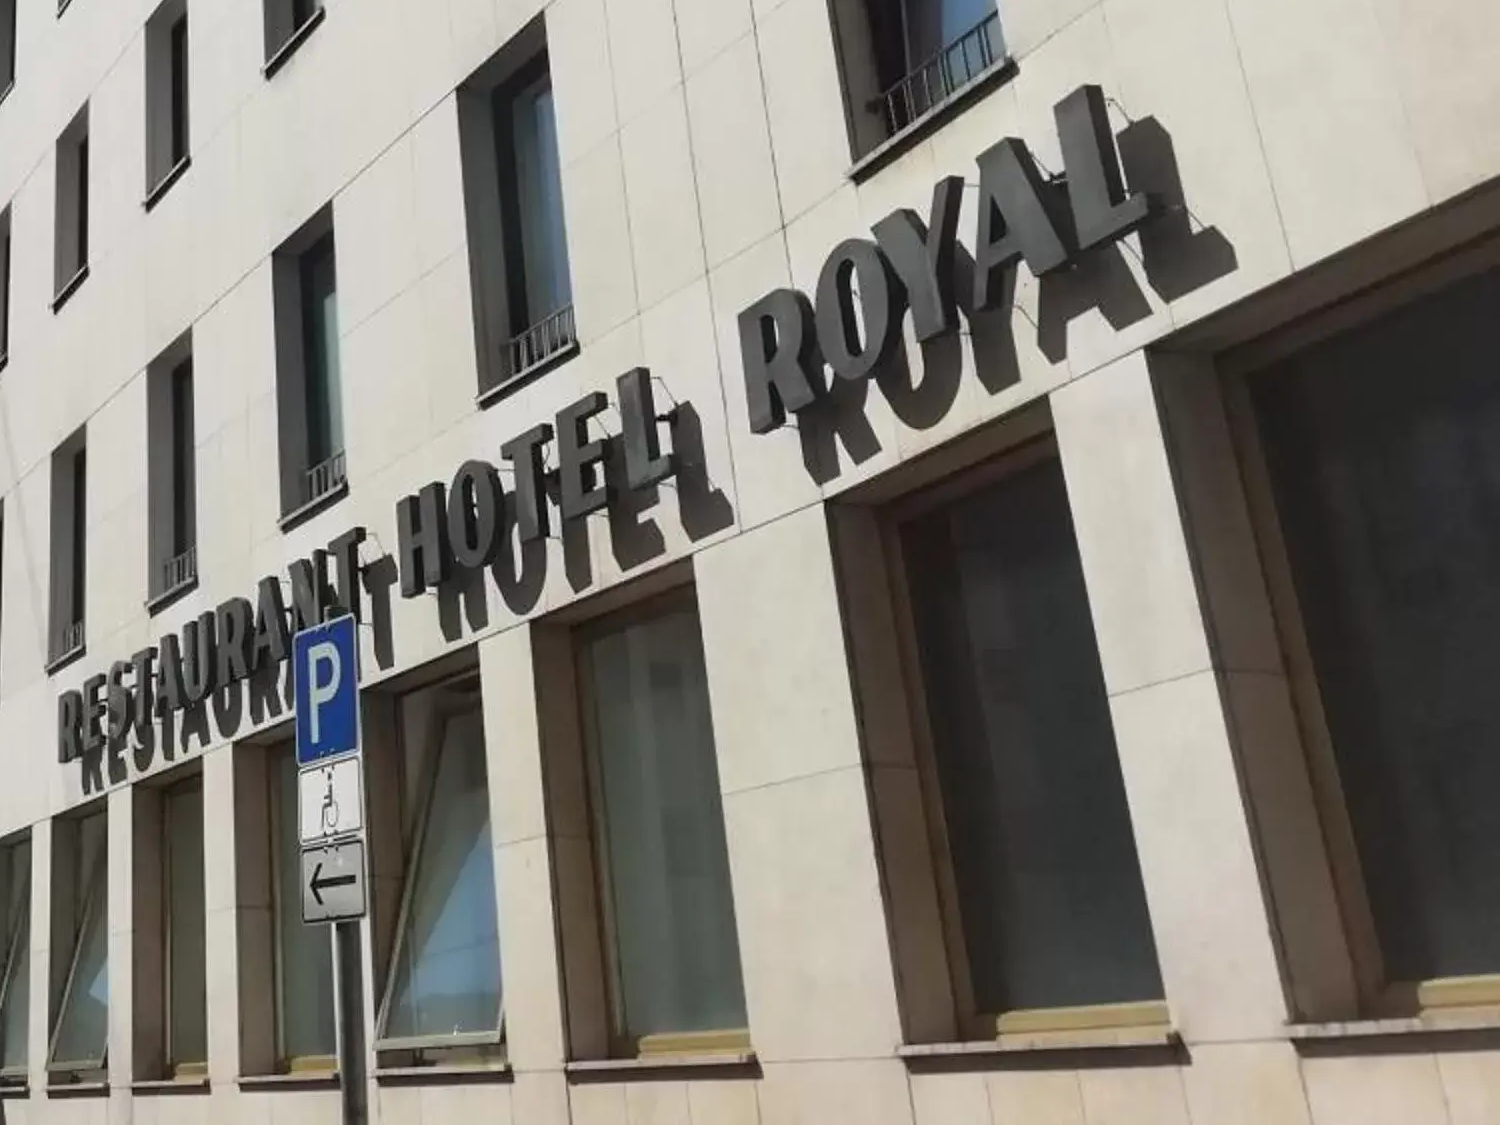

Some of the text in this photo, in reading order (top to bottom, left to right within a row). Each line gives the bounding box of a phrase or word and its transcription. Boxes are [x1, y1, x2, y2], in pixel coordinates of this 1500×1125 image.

[58, 84, 1149, 763] RESTAURANT HOTEL ROYAL
[308, 642, 341, 743] P
